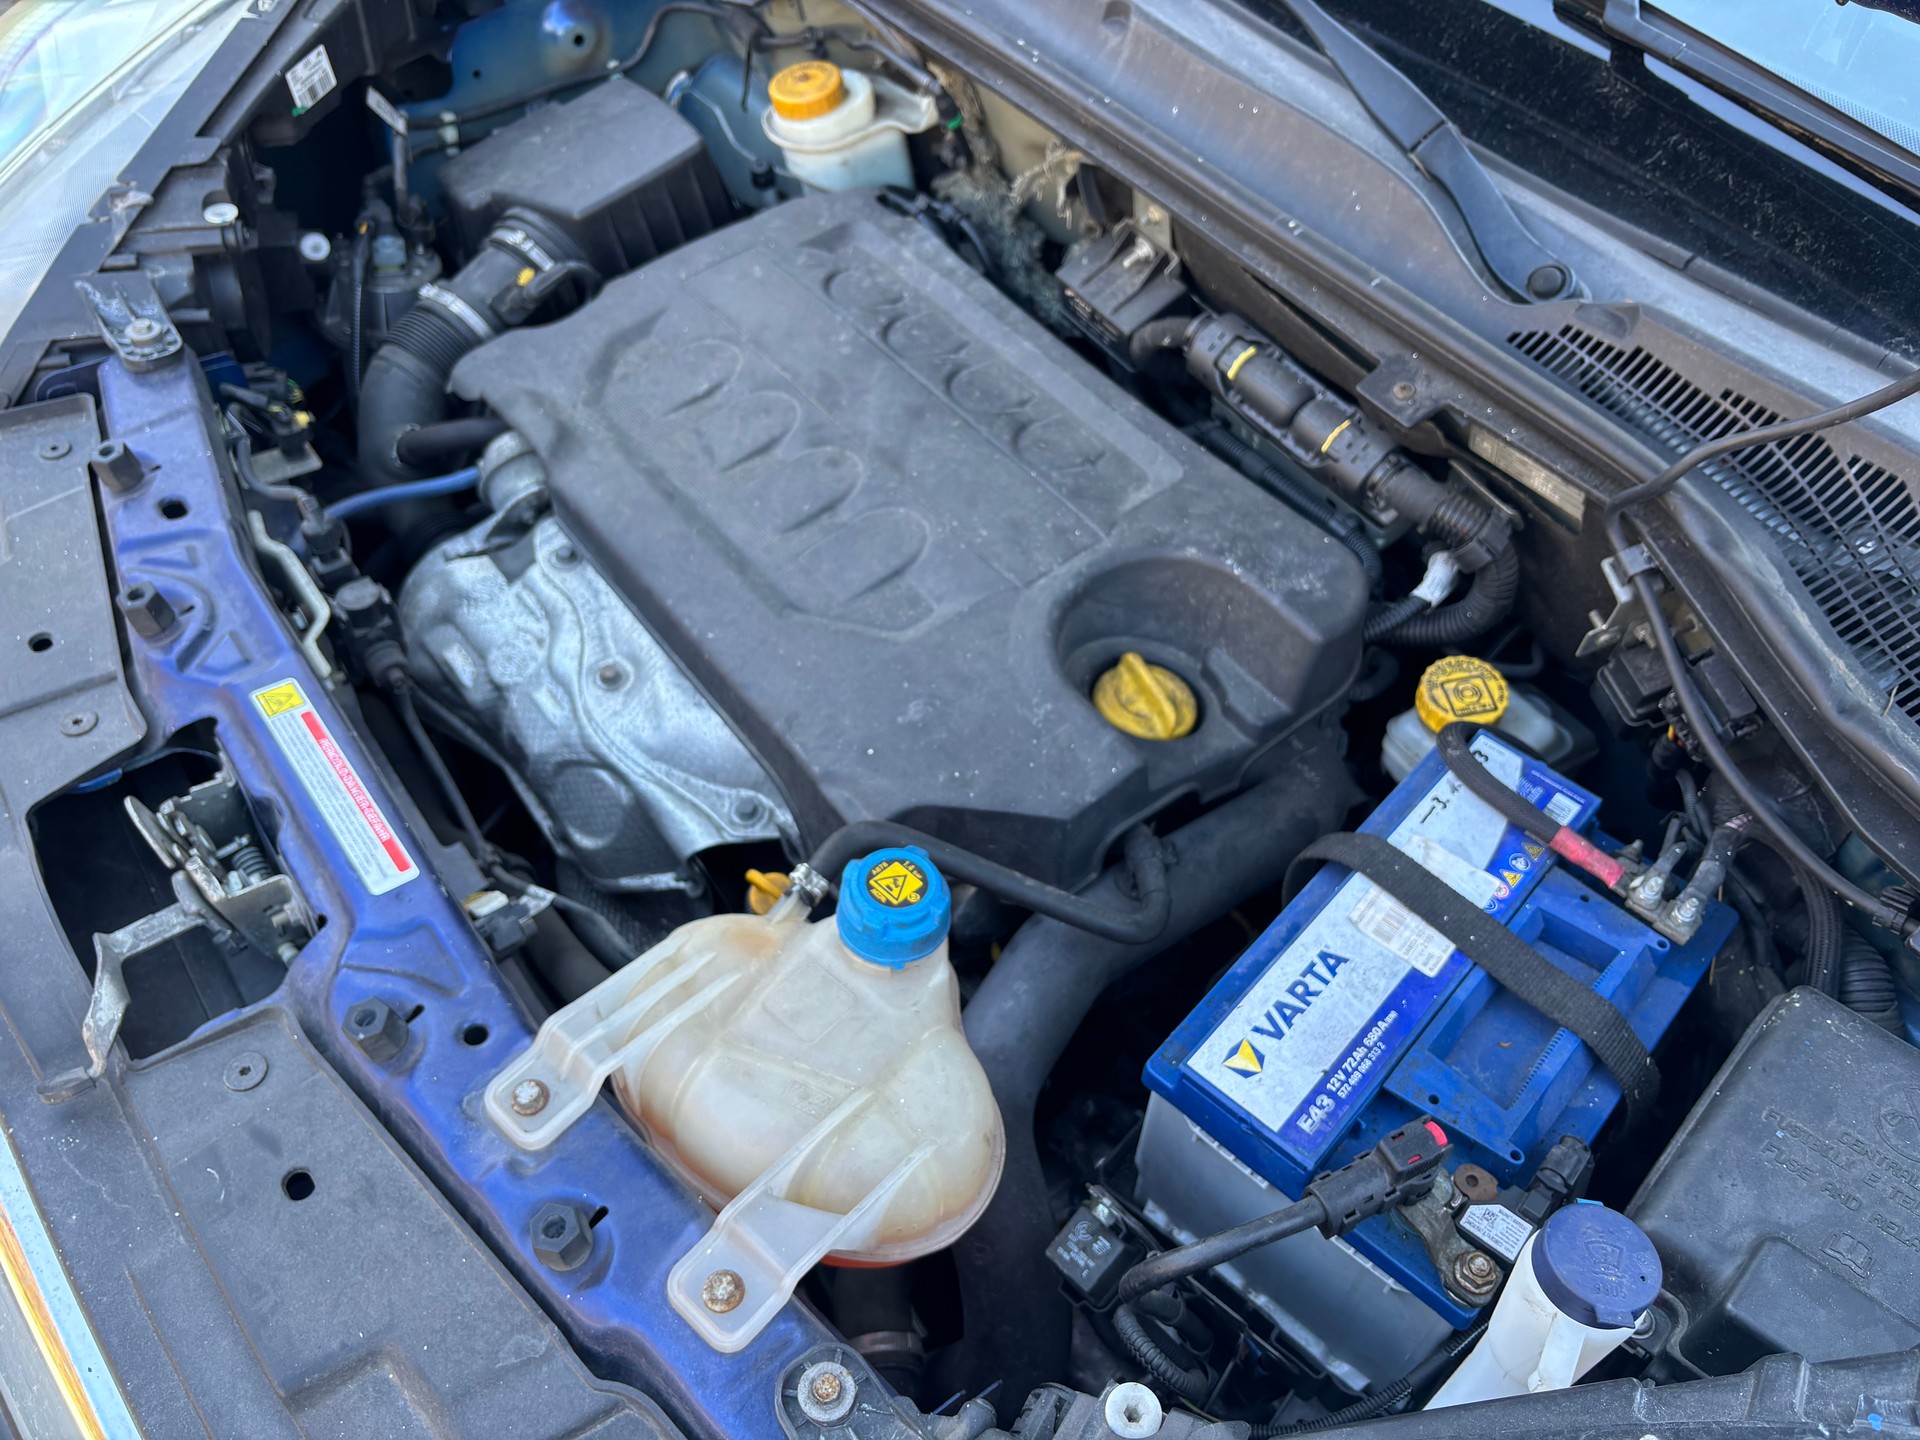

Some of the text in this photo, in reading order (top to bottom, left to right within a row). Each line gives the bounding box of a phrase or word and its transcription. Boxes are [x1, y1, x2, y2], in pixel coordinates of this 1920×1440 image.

[1250, 950, 1350, 1041] VARTA
[1296, 1093, 1336, 1136] E43
[1326, 1069, 1347, 1092] 12V
[1341, 1046, 1369, 1073] 72Ah
[1762, 1141, 1816, 1182] FUSE
[1820, 1181, 1864, 1212] AND
